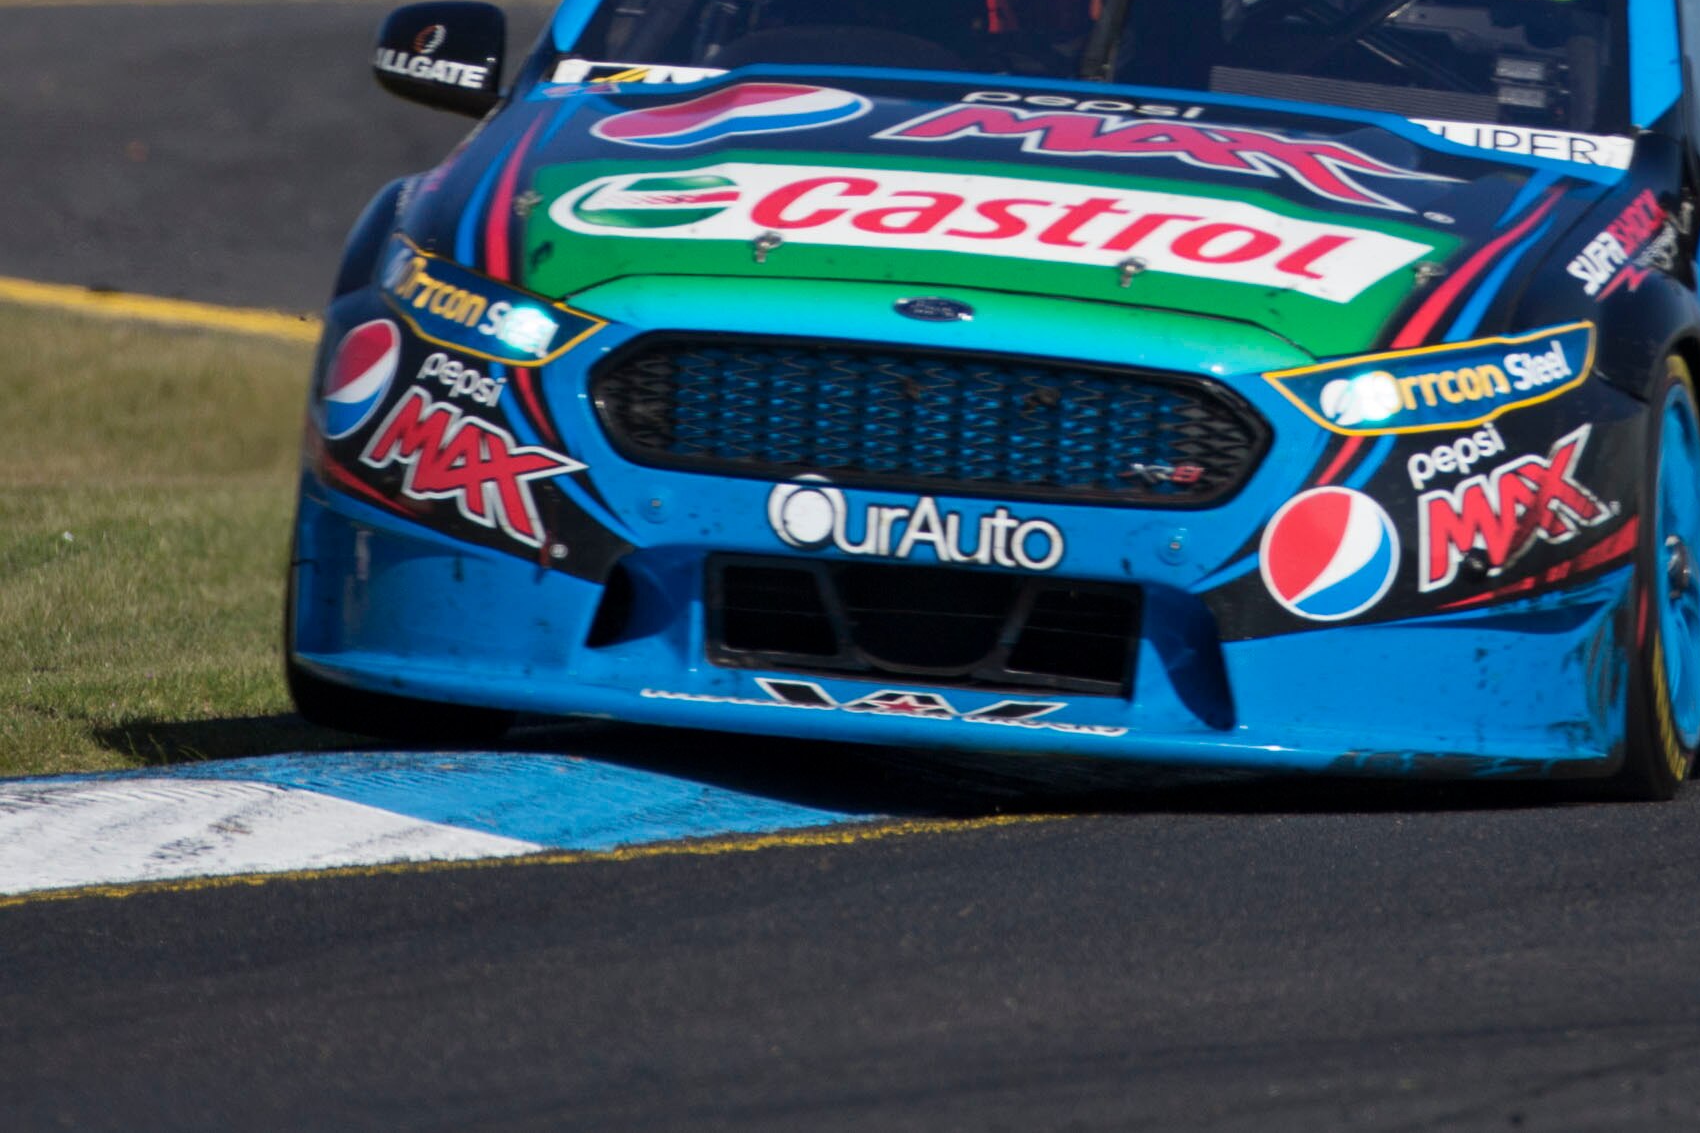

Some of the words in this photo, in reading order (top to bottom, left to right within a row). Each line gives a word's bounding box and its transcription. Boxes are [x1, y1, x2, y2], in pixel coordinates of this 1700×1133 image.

[963, 92, 1204, 119] pepsi
[870, 106, 1470, 215] MAX
[749, 175, 1356, 281] Castrol
[416, 352, 506, 407] pepsi
[358, 385, 589, 549] MAX
[1407, 422, 1505, 490] pepsi
[767, 474, 1065, 571] OurAuto
[1418, 423, 1612, 593] MAX
